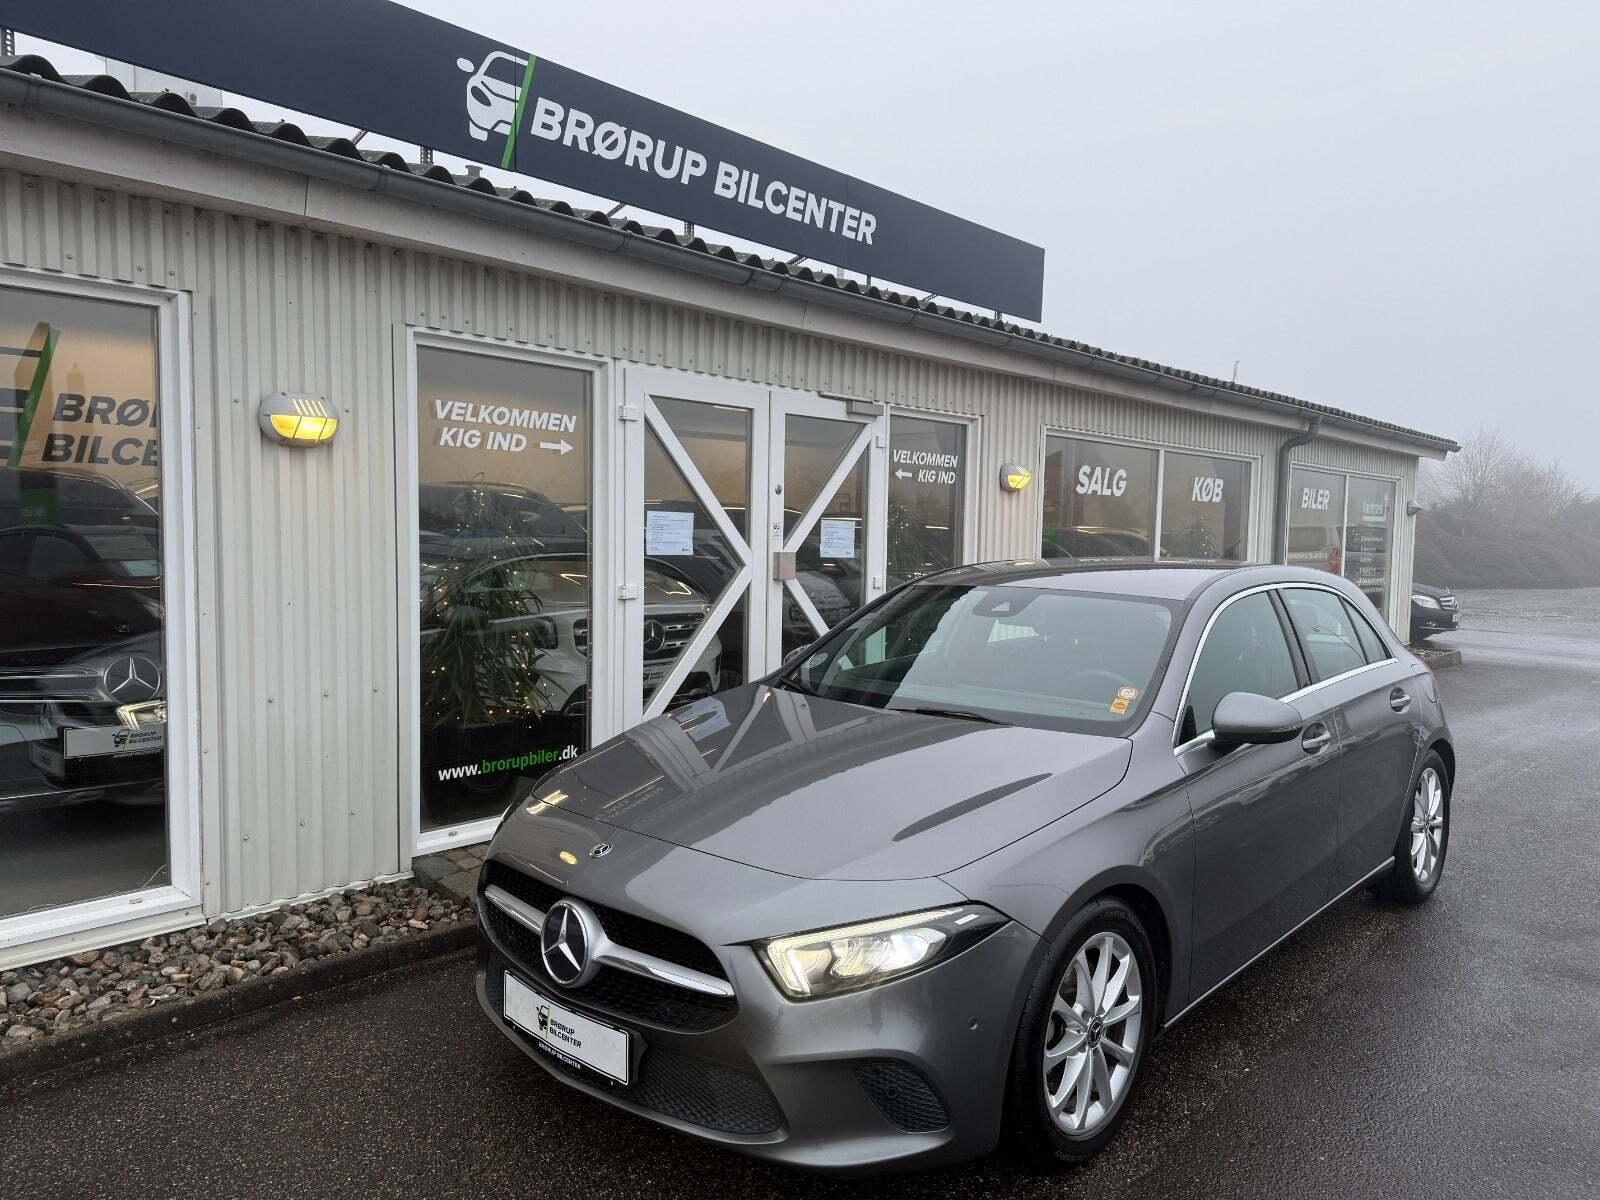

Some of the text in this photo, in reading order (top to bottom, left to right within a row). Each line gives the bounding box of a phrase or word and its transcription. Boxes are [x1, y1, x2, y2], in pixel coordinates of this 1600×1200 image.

[531, 97, 877, 245] BRØRUP BILCENTER
[435, 400, 577, 433] VELKOMMEN
[440, 427, 527, 452] KIG IND
[893, 449, 958, 468] VELKOMMEN
[918, 469, 956, 484] KIG IND
[1076, 465, 1127, 497] SALG
[1192, 476, 1224, 503] KØB
[1301, 487, 1330, 510] BILER
[438, 745, 578, 781] www.brorupbiler.dk
[549, 1027, 582, 1048] BILCENTER
[550, 1018, 575, 1035] BRØRUP
